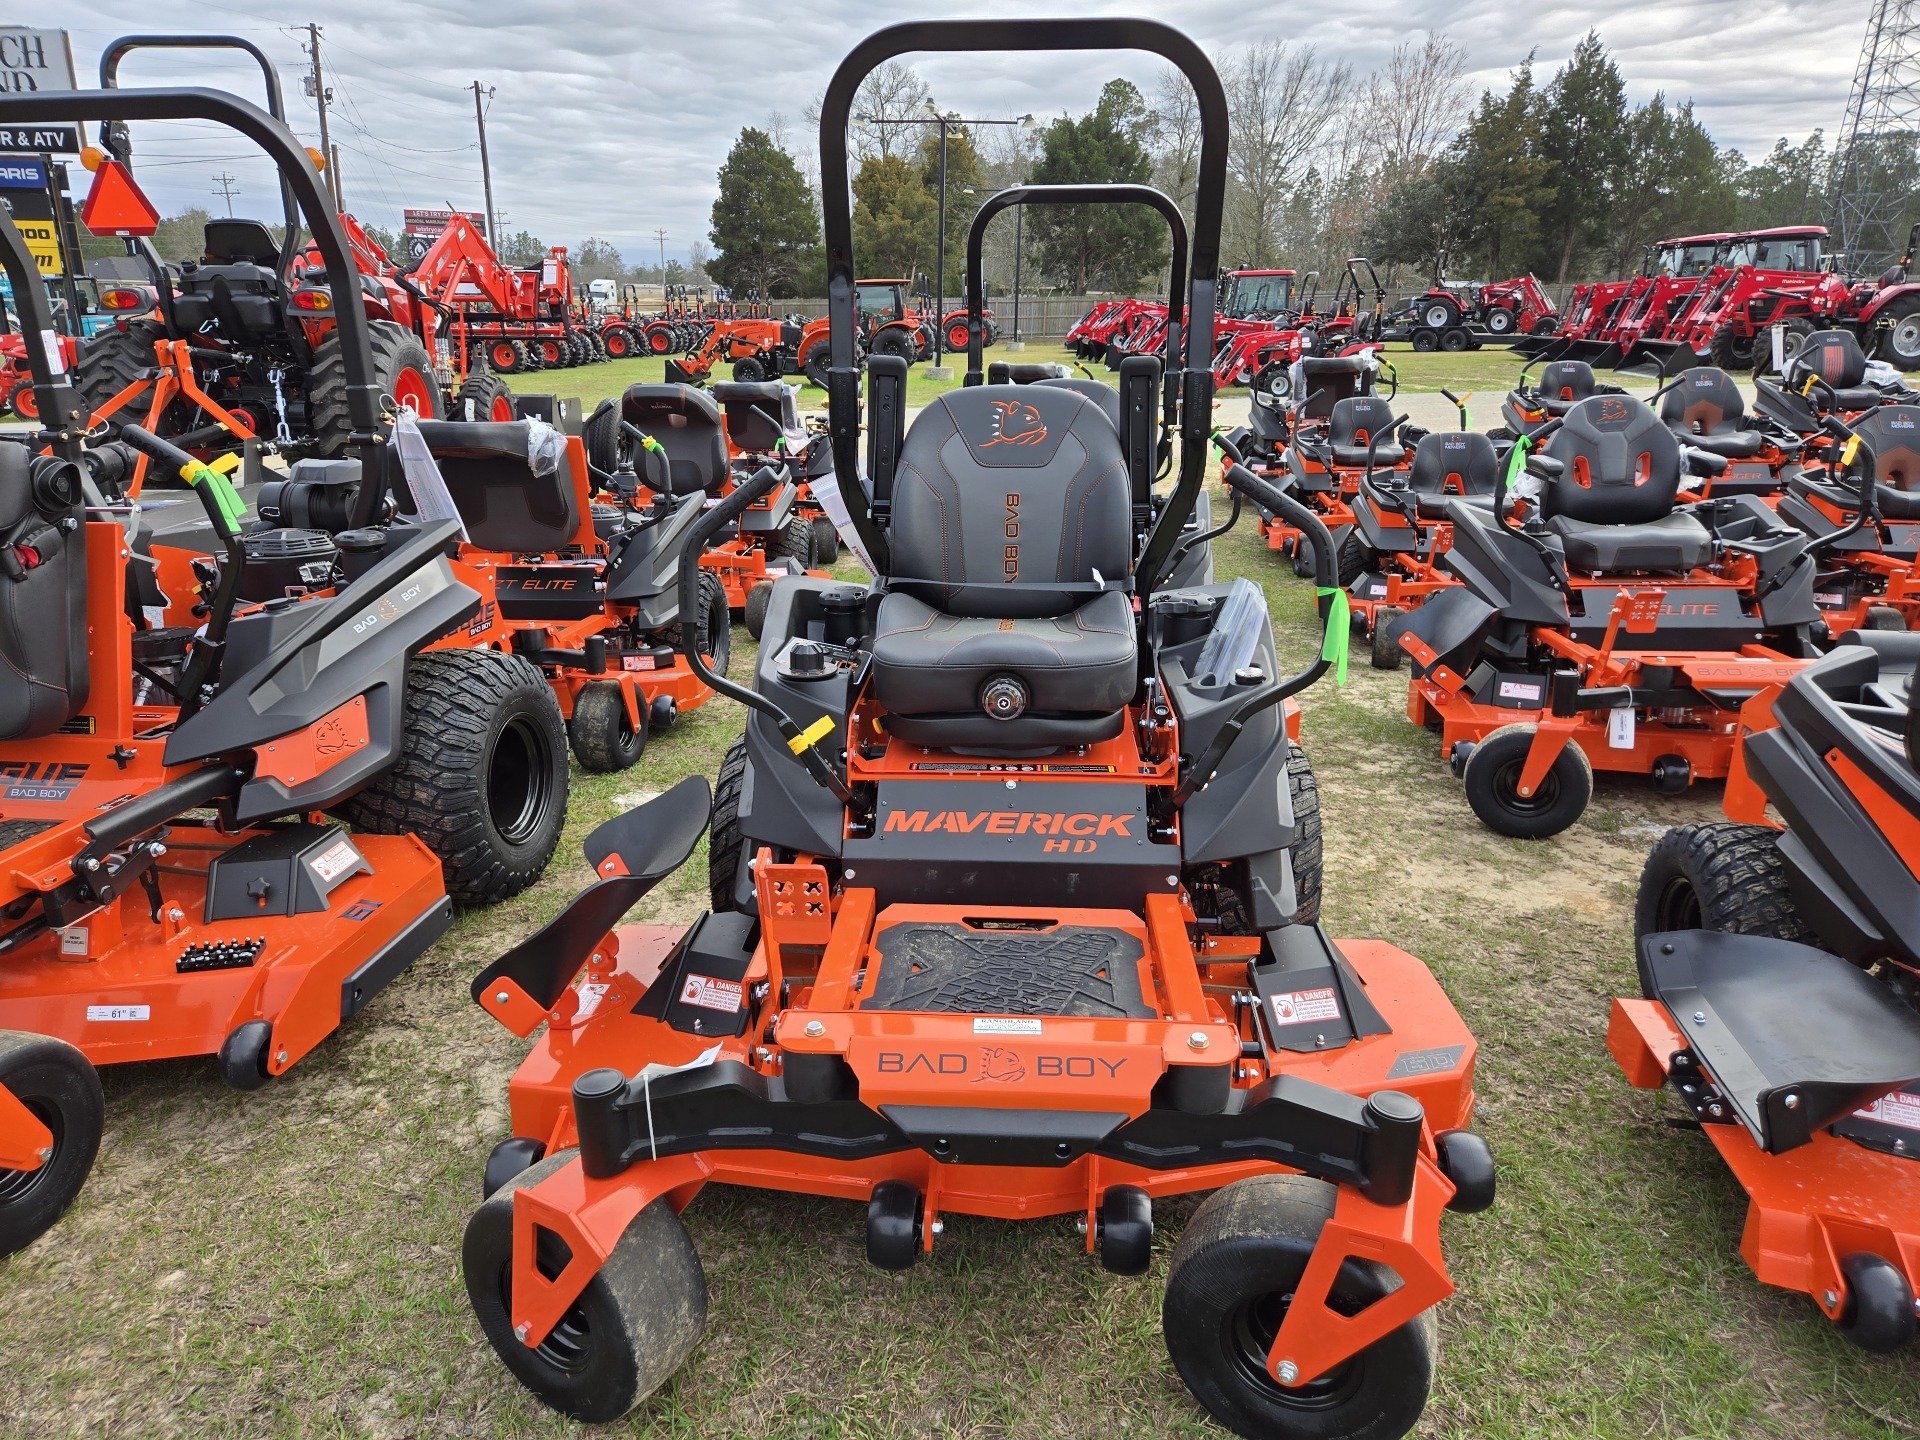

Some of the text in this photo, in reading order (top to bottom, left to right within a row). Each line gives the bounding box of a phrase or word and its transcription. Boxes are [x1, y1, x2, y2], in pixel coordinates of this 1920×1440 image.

[17, 131, 32, 147] &
[34, 131, 64, 147] ATV
[1003, 492, 1020, 584] BAD BOY
[521, 579, 578, 590] ELITE
[353, 584, 421, 633] BAD BOY
[481, 620, 492, 630] BOY
[1697, 668, 1743, 676] BAD
[10, 788, 66, 798] BAD BOY
[883, 809, 1136, 837] MAVERICK
[1043, 838, 1098, 853] HD
[715, 981, 742, 994] DANGER
[1304, 990, 1334, 1001] DANGER
[877, 1052, 1128, 1078] BAD BOY
